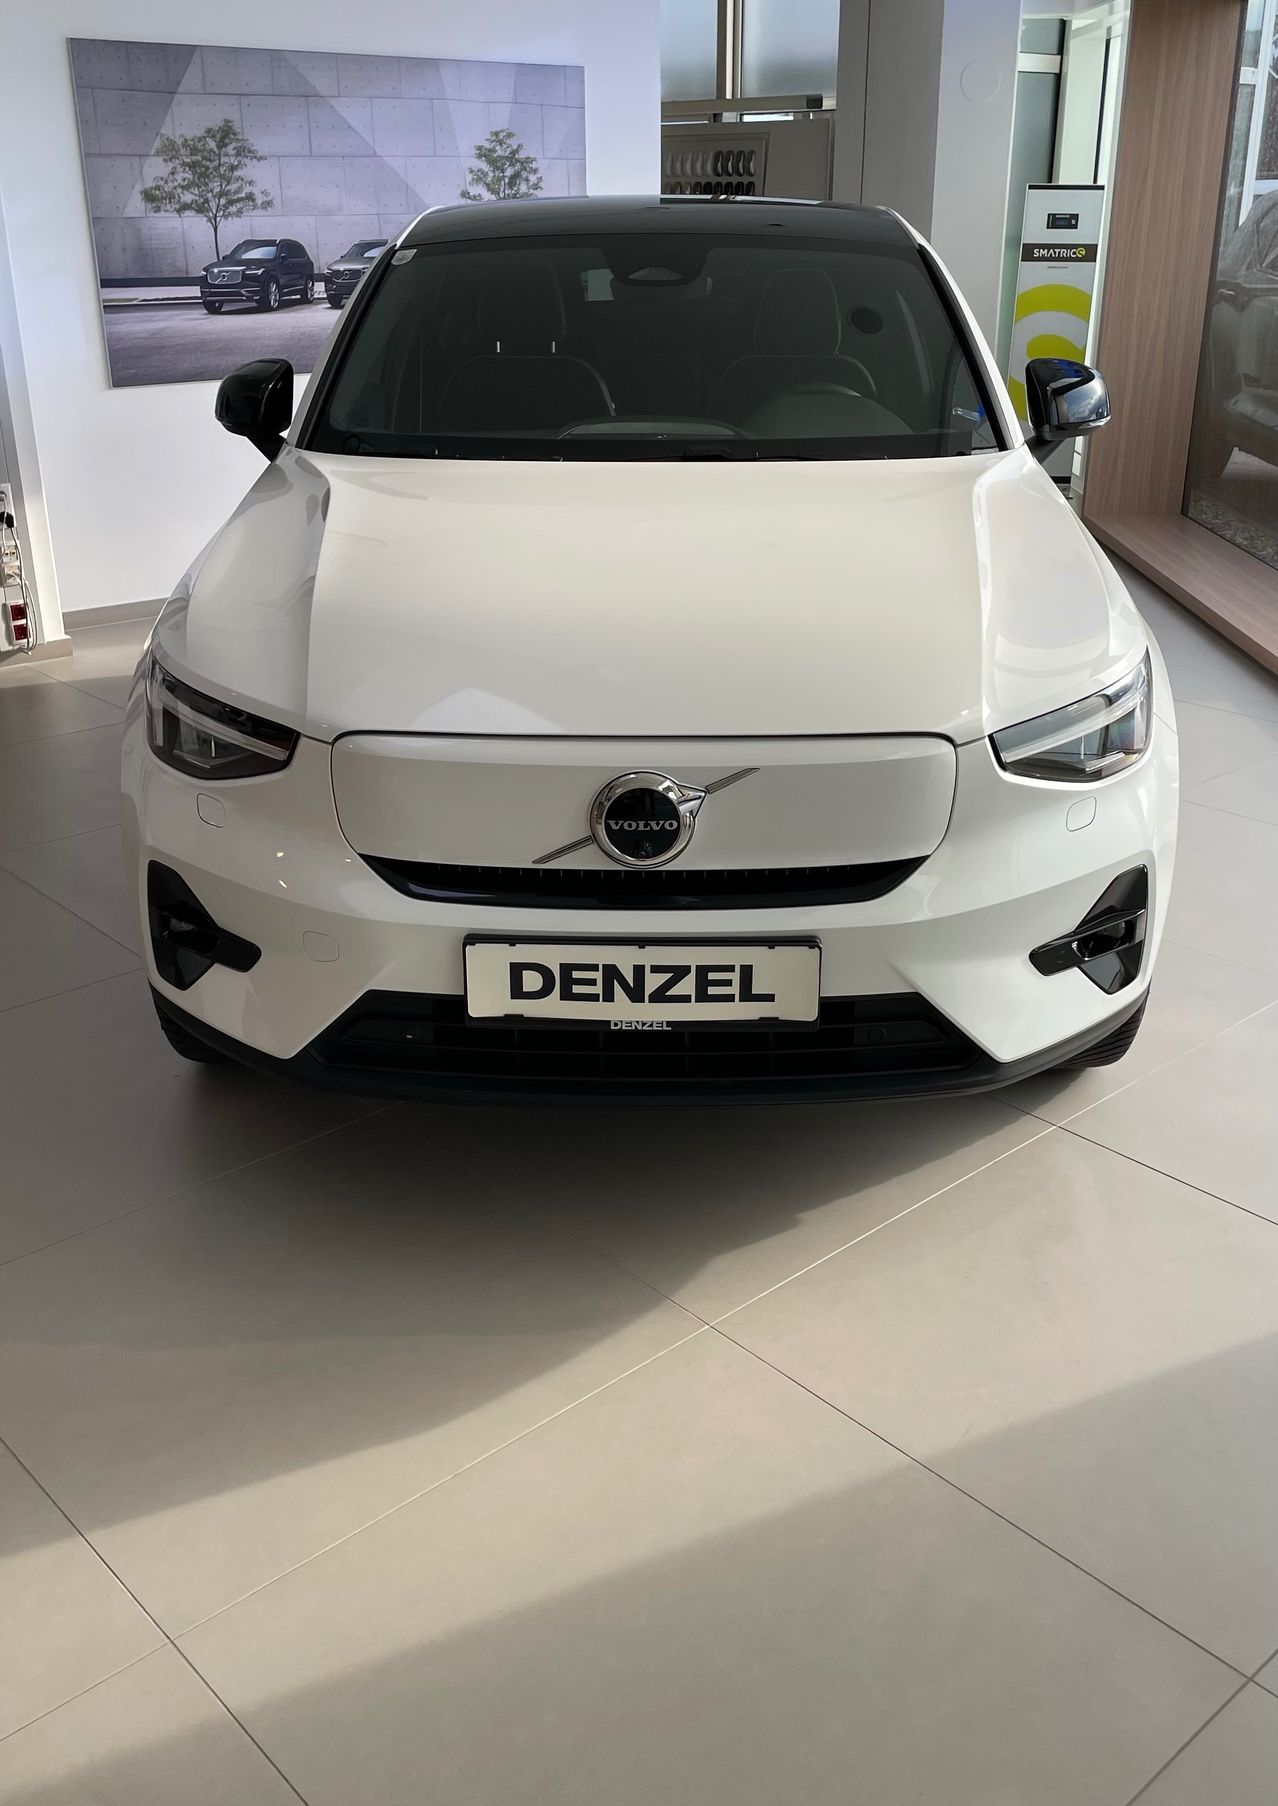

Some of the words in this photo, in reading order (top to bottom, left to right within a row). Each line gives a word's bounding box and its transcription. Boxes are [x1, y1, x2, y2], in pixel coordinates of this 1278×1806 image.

[606, 820, 678, 831] VOLVO
[509, 961, 776, 1004] DENZEL
[610, 1020, 672, 1030] DENZEL
